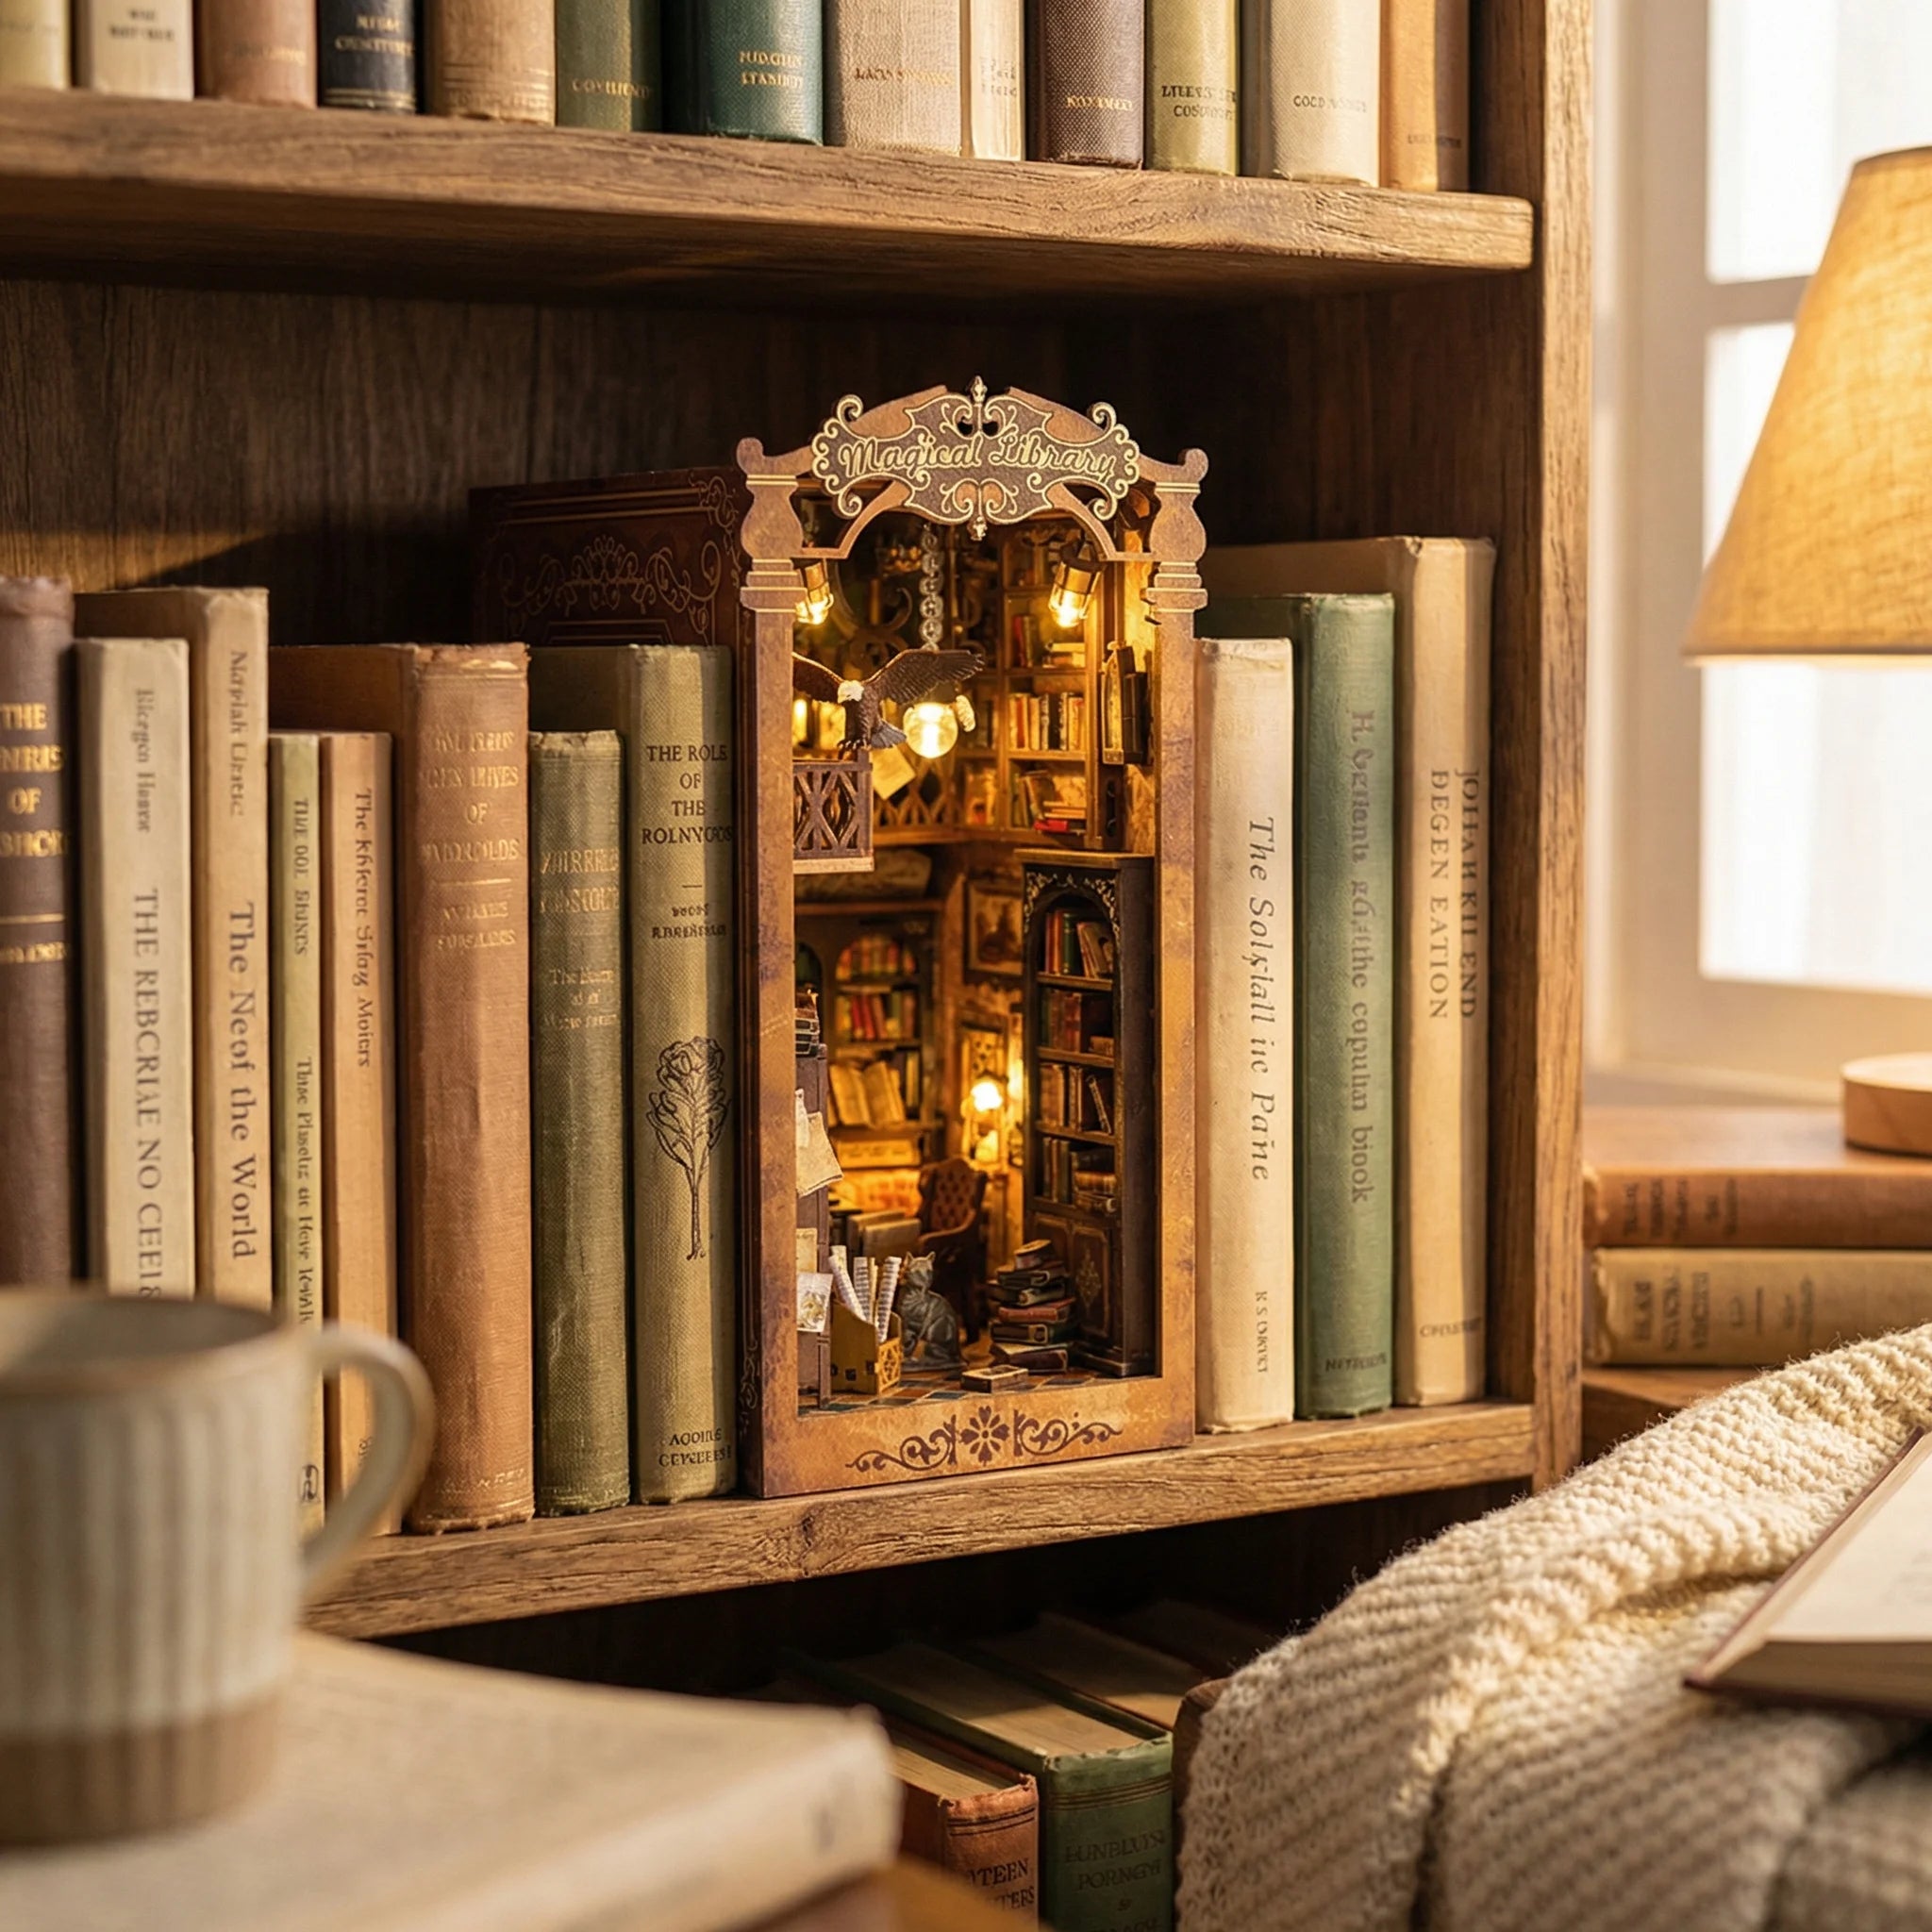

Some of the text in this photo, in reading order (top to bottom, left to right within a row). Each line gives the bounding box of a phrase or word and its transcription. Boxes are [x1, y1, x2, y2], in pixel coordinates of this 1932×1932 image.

[841, 431, 1119, 481] Magical Library
[646, 745, 682, 762] THE
[679, 773, 702, 790] OF
[10, 786, 42, 814] OF
[1249, 816, 1274, 881] The
[134, 888, 160, 958] THE
[229, 902, 256, 974] The
[1429, 894, 1450, 1019] EATION
[1460, 952, 1479, 1019] END
[230, 1086, 258, 1141] the
[137, 1139, 162, 1190] NO
[231, 1154, 258, 1259] World
